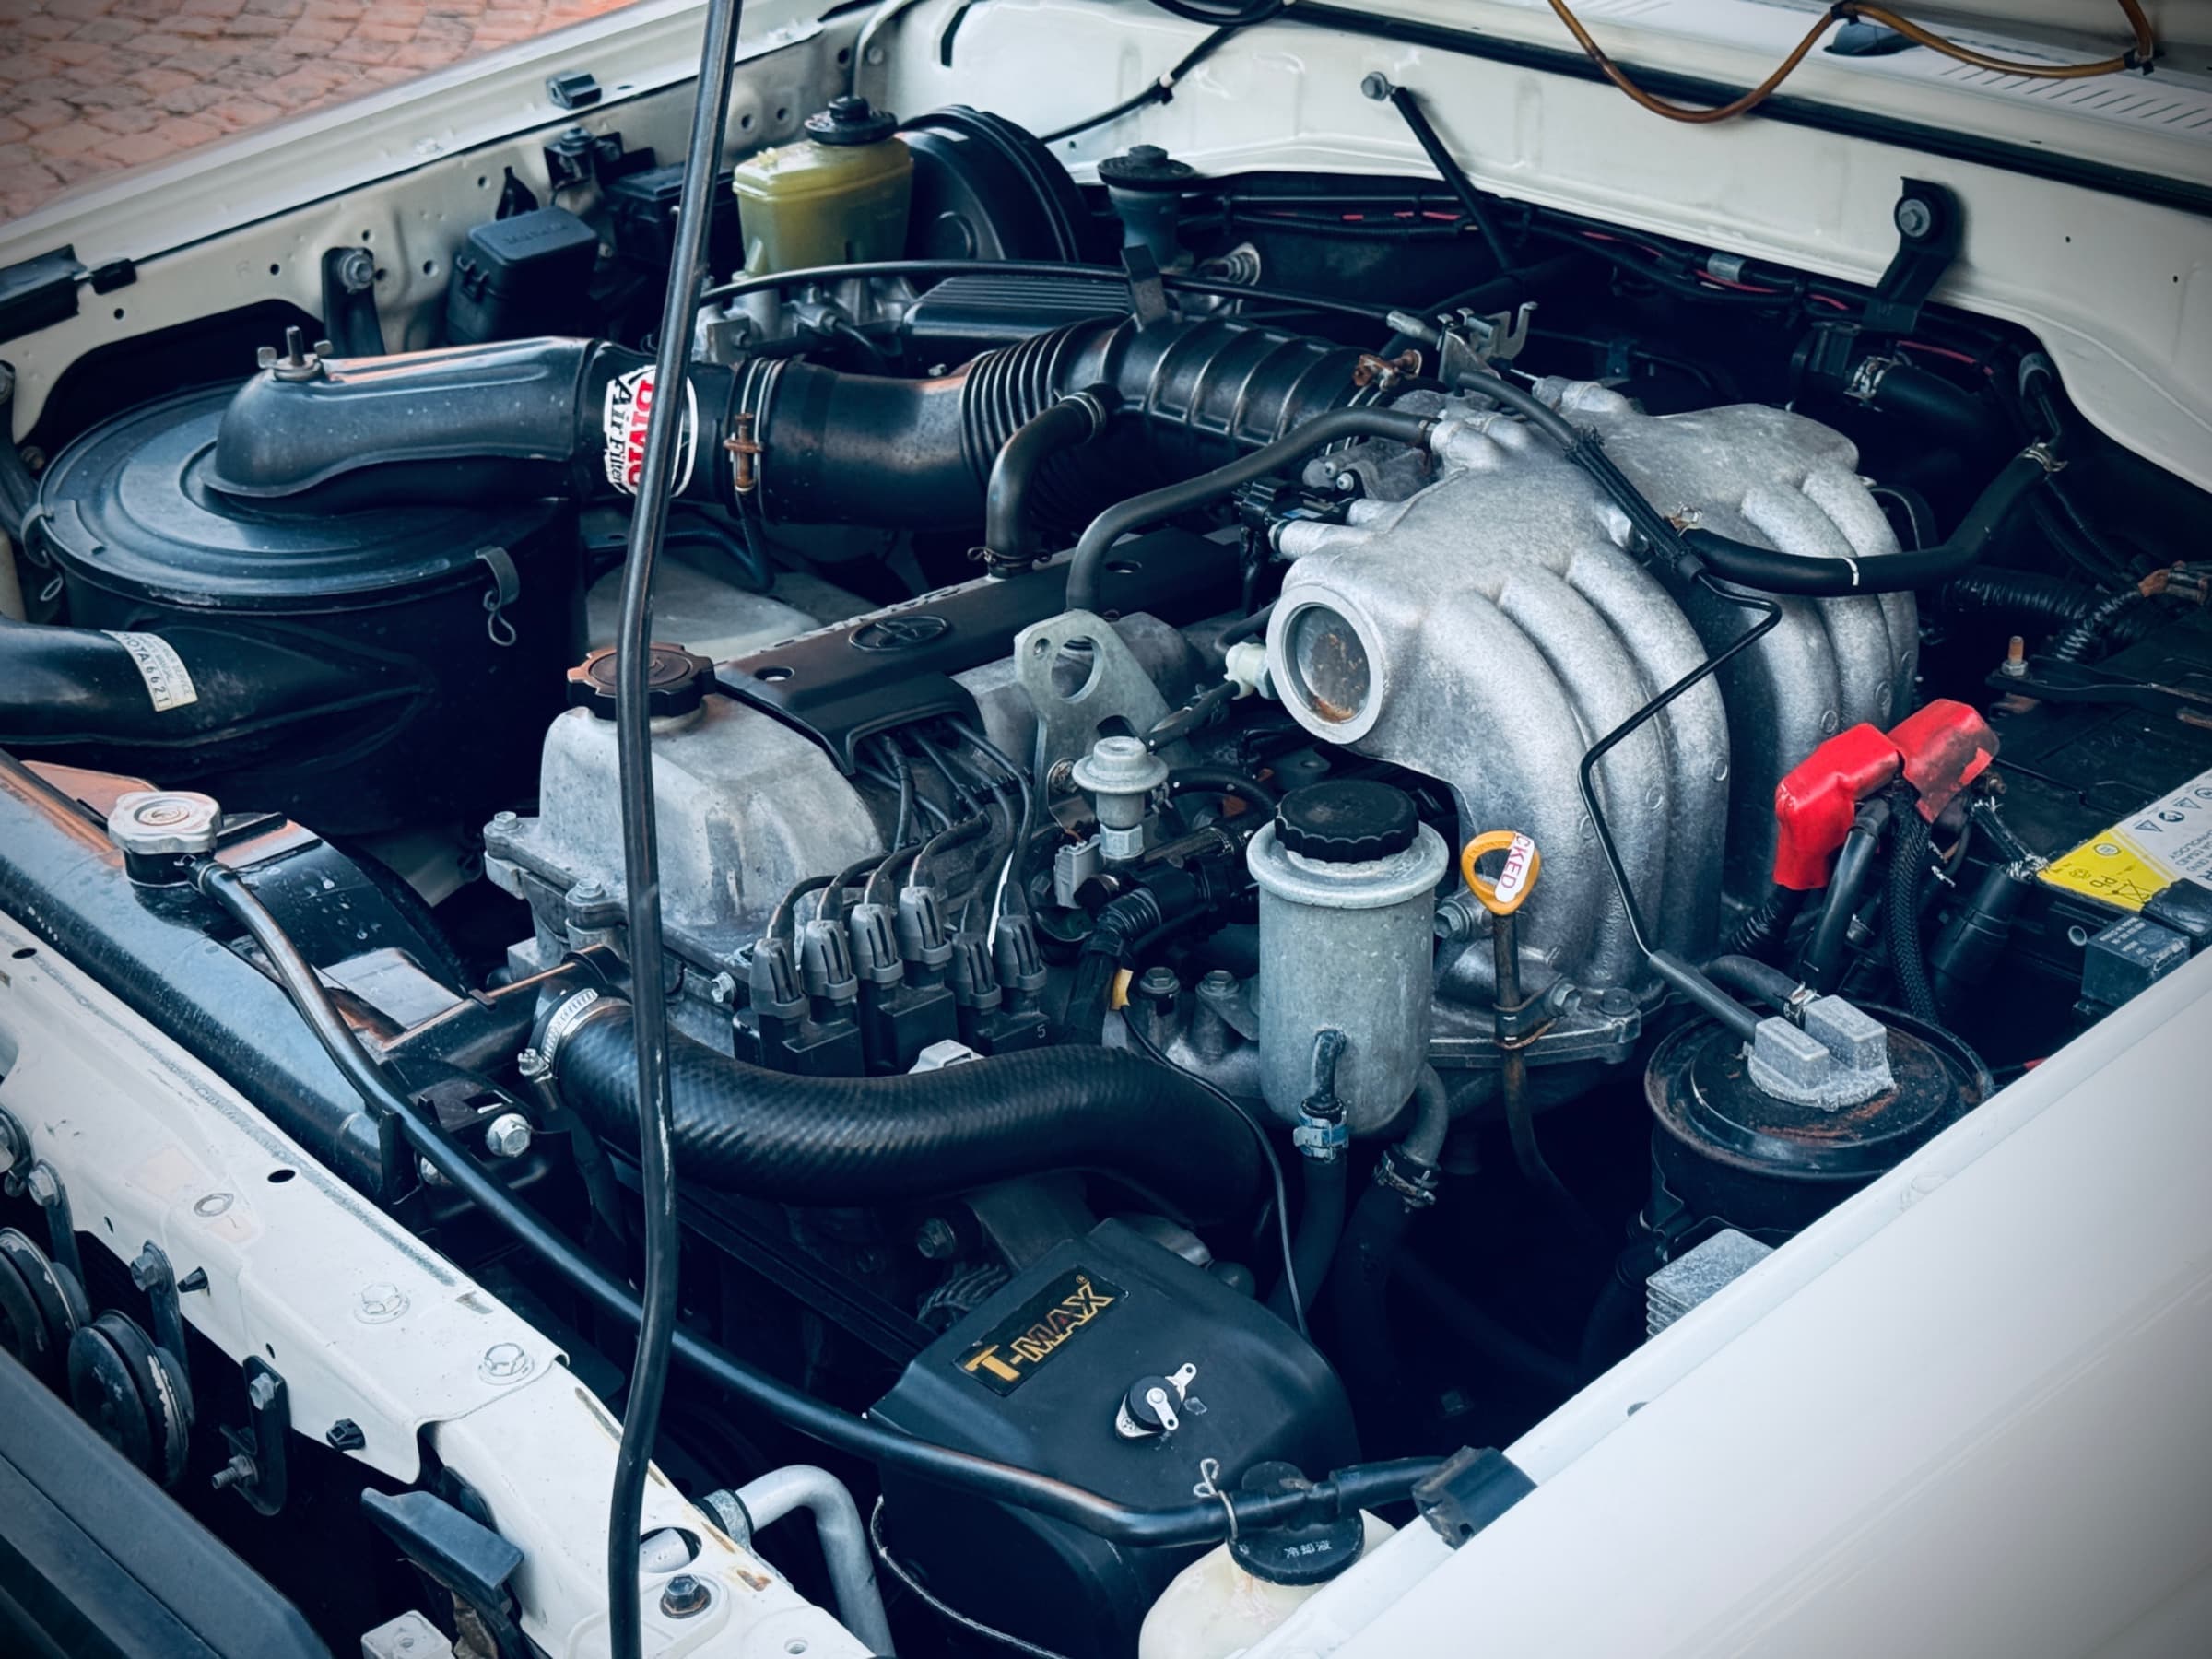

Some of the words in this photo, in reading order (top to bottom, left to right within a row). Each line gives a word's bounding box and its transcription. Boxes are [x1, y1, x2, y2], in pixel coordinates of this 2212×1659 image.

[611, 377, 633, 435] Air
[609, 436, 627, 486] Filter
[2089, 875, 2117, 888] Pb
[1036, 1023, 1047, 1039] 5
[963, 1282, 1115, 1382] T-MAX
